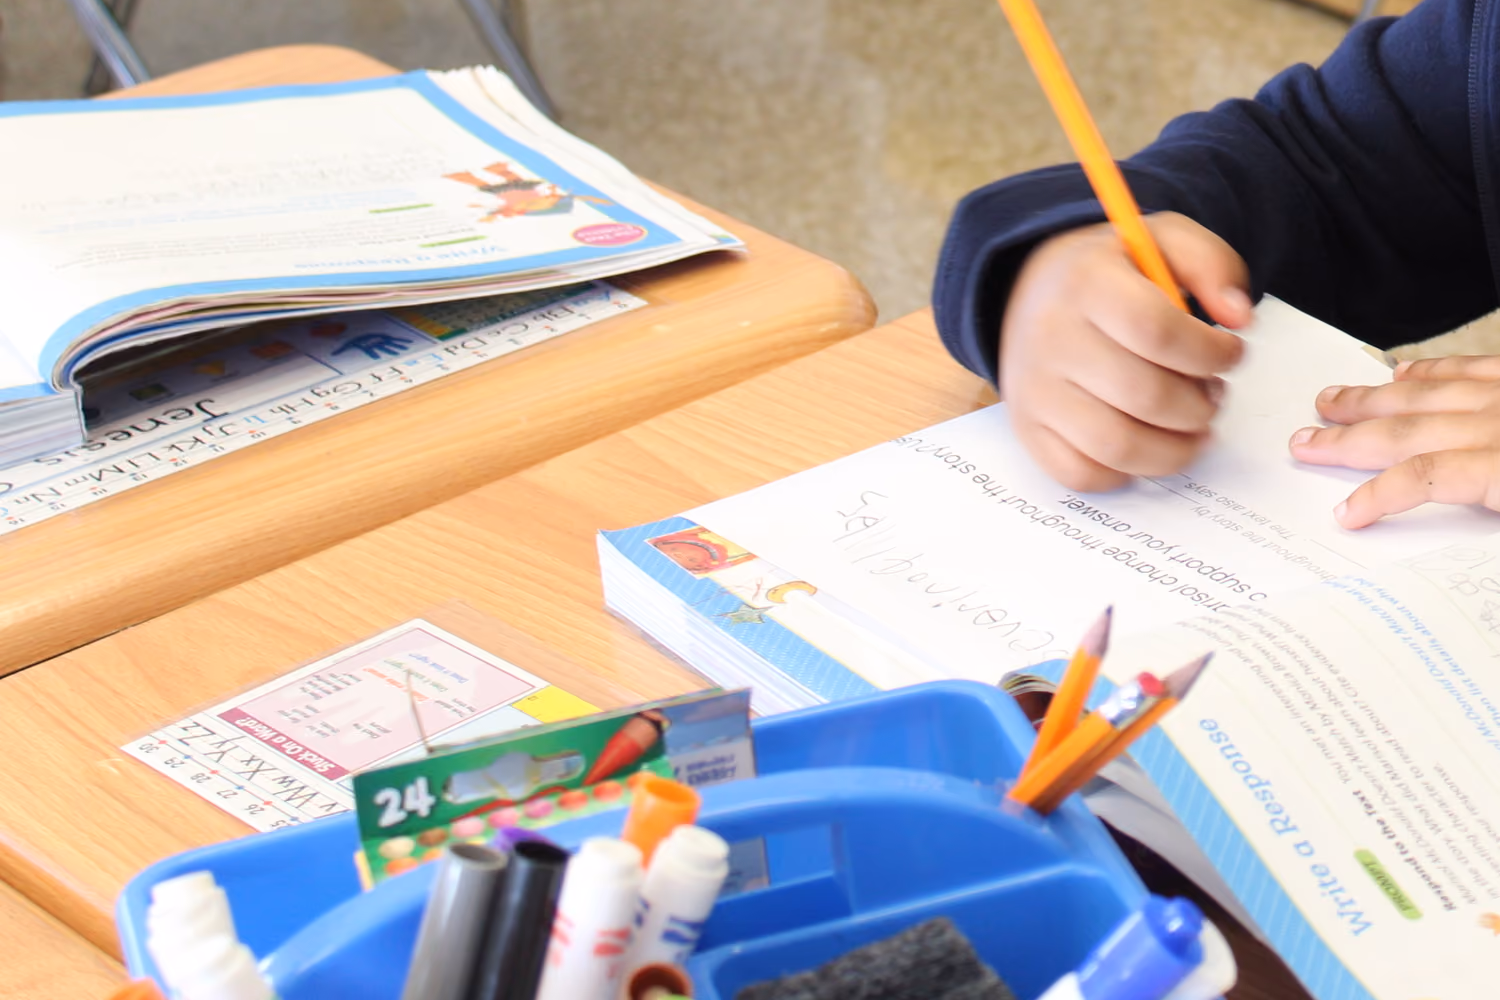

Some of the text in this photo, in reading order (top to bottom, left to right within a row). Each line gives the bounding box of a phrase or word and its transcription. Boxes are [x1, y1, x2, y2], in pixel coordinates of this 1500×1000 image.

[270, 397, 315, 415] Hh
[310, 382, 362, 398] Gg
[34, 397, 229, 466] Jenesis
[161, 435, 206, 453] Kk
[64, 463, 124, 483] Mm
[965, 465, 1005, 497] the
[13, 487, 62, 505] Nn
[1184, 477, 1297, 540] The text also says
[999, 496, 1105, 550] throughout
[1058, 495, 1131, 532] answer.
[1126, 532, 1178, 554] your
[1192, 502, 1337, 582] throughout the story by
[1102, 547, 1178, 585] change
[1169, 545, 1251, 593] support
[1346, 589, 1373, 604] that
[1371, 605, 1407, 634] Match
[1397, 607, 1431, 635] about
[1295, 634, 1340, 675] evidence
[1402, 637, 1444, 676] Doesn't
[1429, 639, 1465, 675] details
[1250, 665, 1303, 719] interesting
[1283, 673, 1321, 711] Monica
[1312, 677, 1344, 707] about
[1336, 677, 1358, 697] Cite
[1462, 678, 1481, 695] list
[1317, 713, 1334, 726] by
[1340, 709, 1366, 738] learn
[1438, 680, 1494, 737] McDonald
[239, 716, 335, 772] Stuck On a Word?
[1300, 721, 1316, 734] an
[174, 718, 319, 806] Ww Xx Yy Zz
[1312, 737, 1335, 759] met
[1330, 728, 1362, 763] Match
[1362, 740, 1401, 780] Marisol
[1385, 739, 1413, 764] read
[138, 740, 265, 815] 26 27 28 29 30
[1331, 762, 1352, 784] You
[1358, 765, 1397, 805] Doesn't
[1410, 766, 1424, 779] to
[373, 775, 436, 828] 24
[1353, 790, 1376, 816] Text
[1395, 783, 1417, 801] did
[1421, 781, 1468, 832] character
[1200, 720, 1372, 936] Write a Response
[1376, 818, 1396, 839] the
[1389, 808, 1441, 863] McDonald
[1414, 805, 1443, 834] What
[1395, 841, 1408, 855] to
[1362, 857, 1414, 912] PROMPT
[1404, 857, 1456, 910] Respond
[1438, 866, 1477, 904] Marisol
[1468, 867, 1489, 886] the
